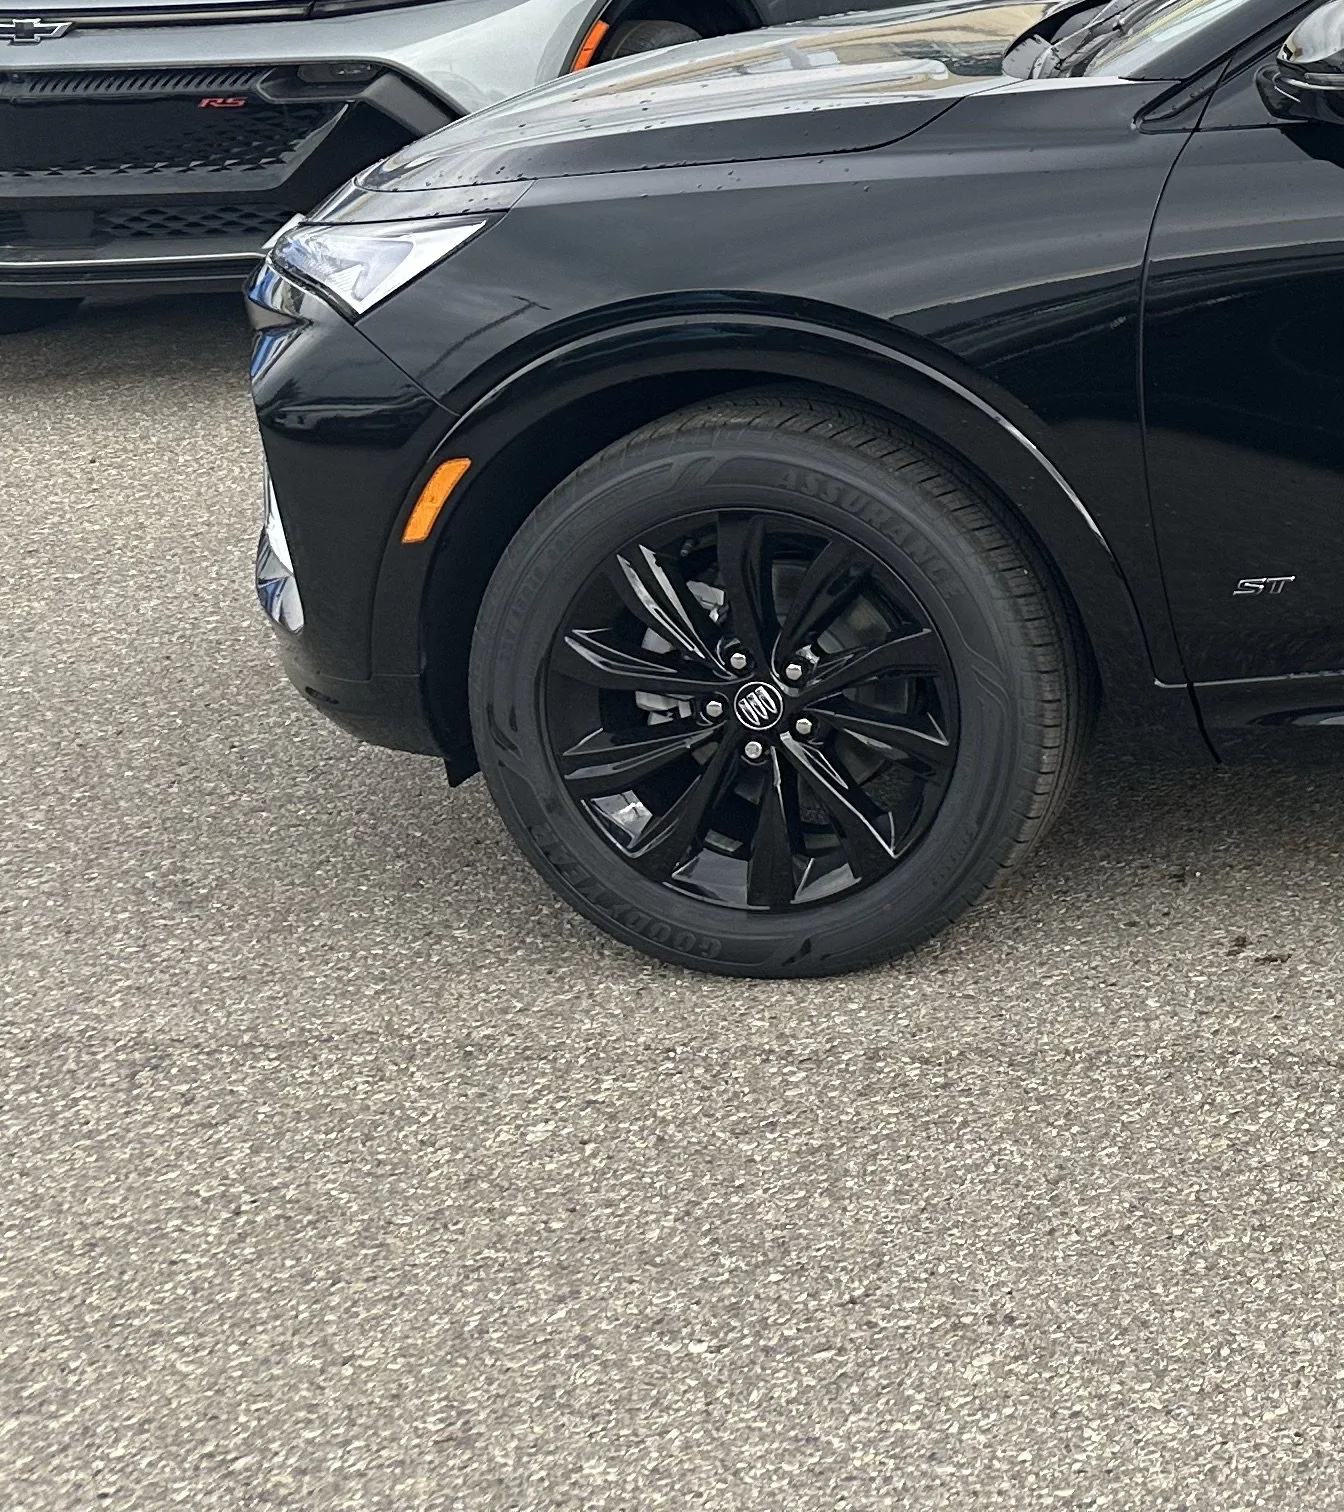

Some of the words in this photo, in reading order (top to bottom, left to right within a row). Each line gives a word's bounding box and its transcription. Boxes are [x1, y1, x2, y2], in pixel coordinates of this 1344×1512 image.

[198, 96, 248, 108] RS
[777, 469, 964, 602] ASSURANCE
[1232, 575, 1296, 597] ST
[529, 820, 722, 958] GOODYEAR
